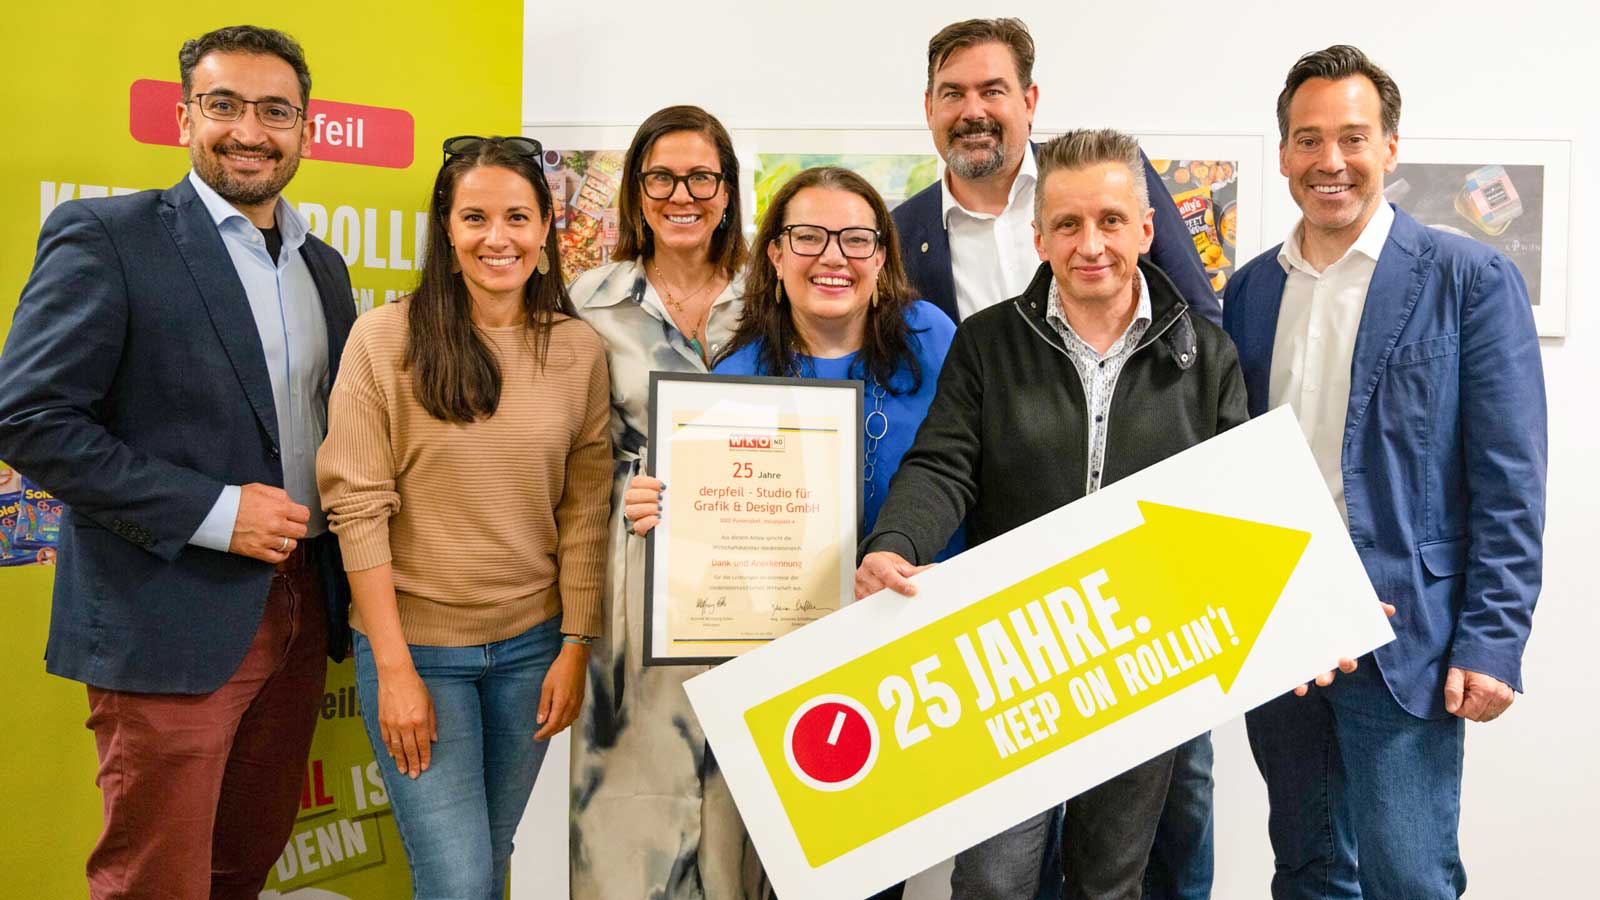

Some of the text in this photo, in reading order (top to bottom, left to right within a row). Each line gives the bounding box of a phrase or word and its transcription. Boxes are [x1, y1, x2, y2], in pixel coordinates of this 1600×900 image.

[314, 113, 363, 148] feil
[729, 435, 770, 448] WKO
[732, 462, 781, 479] 25 Jahre
[699, 486, 744, 498] derpfeil
[756, 487, 792, 498] Studio
[795, 488, 813, 499] für
[694, 500, 820, 514] Grafik & Design GmbH
[712, 559, 730, 568] Dank
[734, 559, 749, 568] und
[878, 568, 1152, 750] 25 JAHRE.
[984, 692, 1061, 759] KEEP
[1069, 666, 1118, 718] ON
[351, 761, 390, 811] IS
